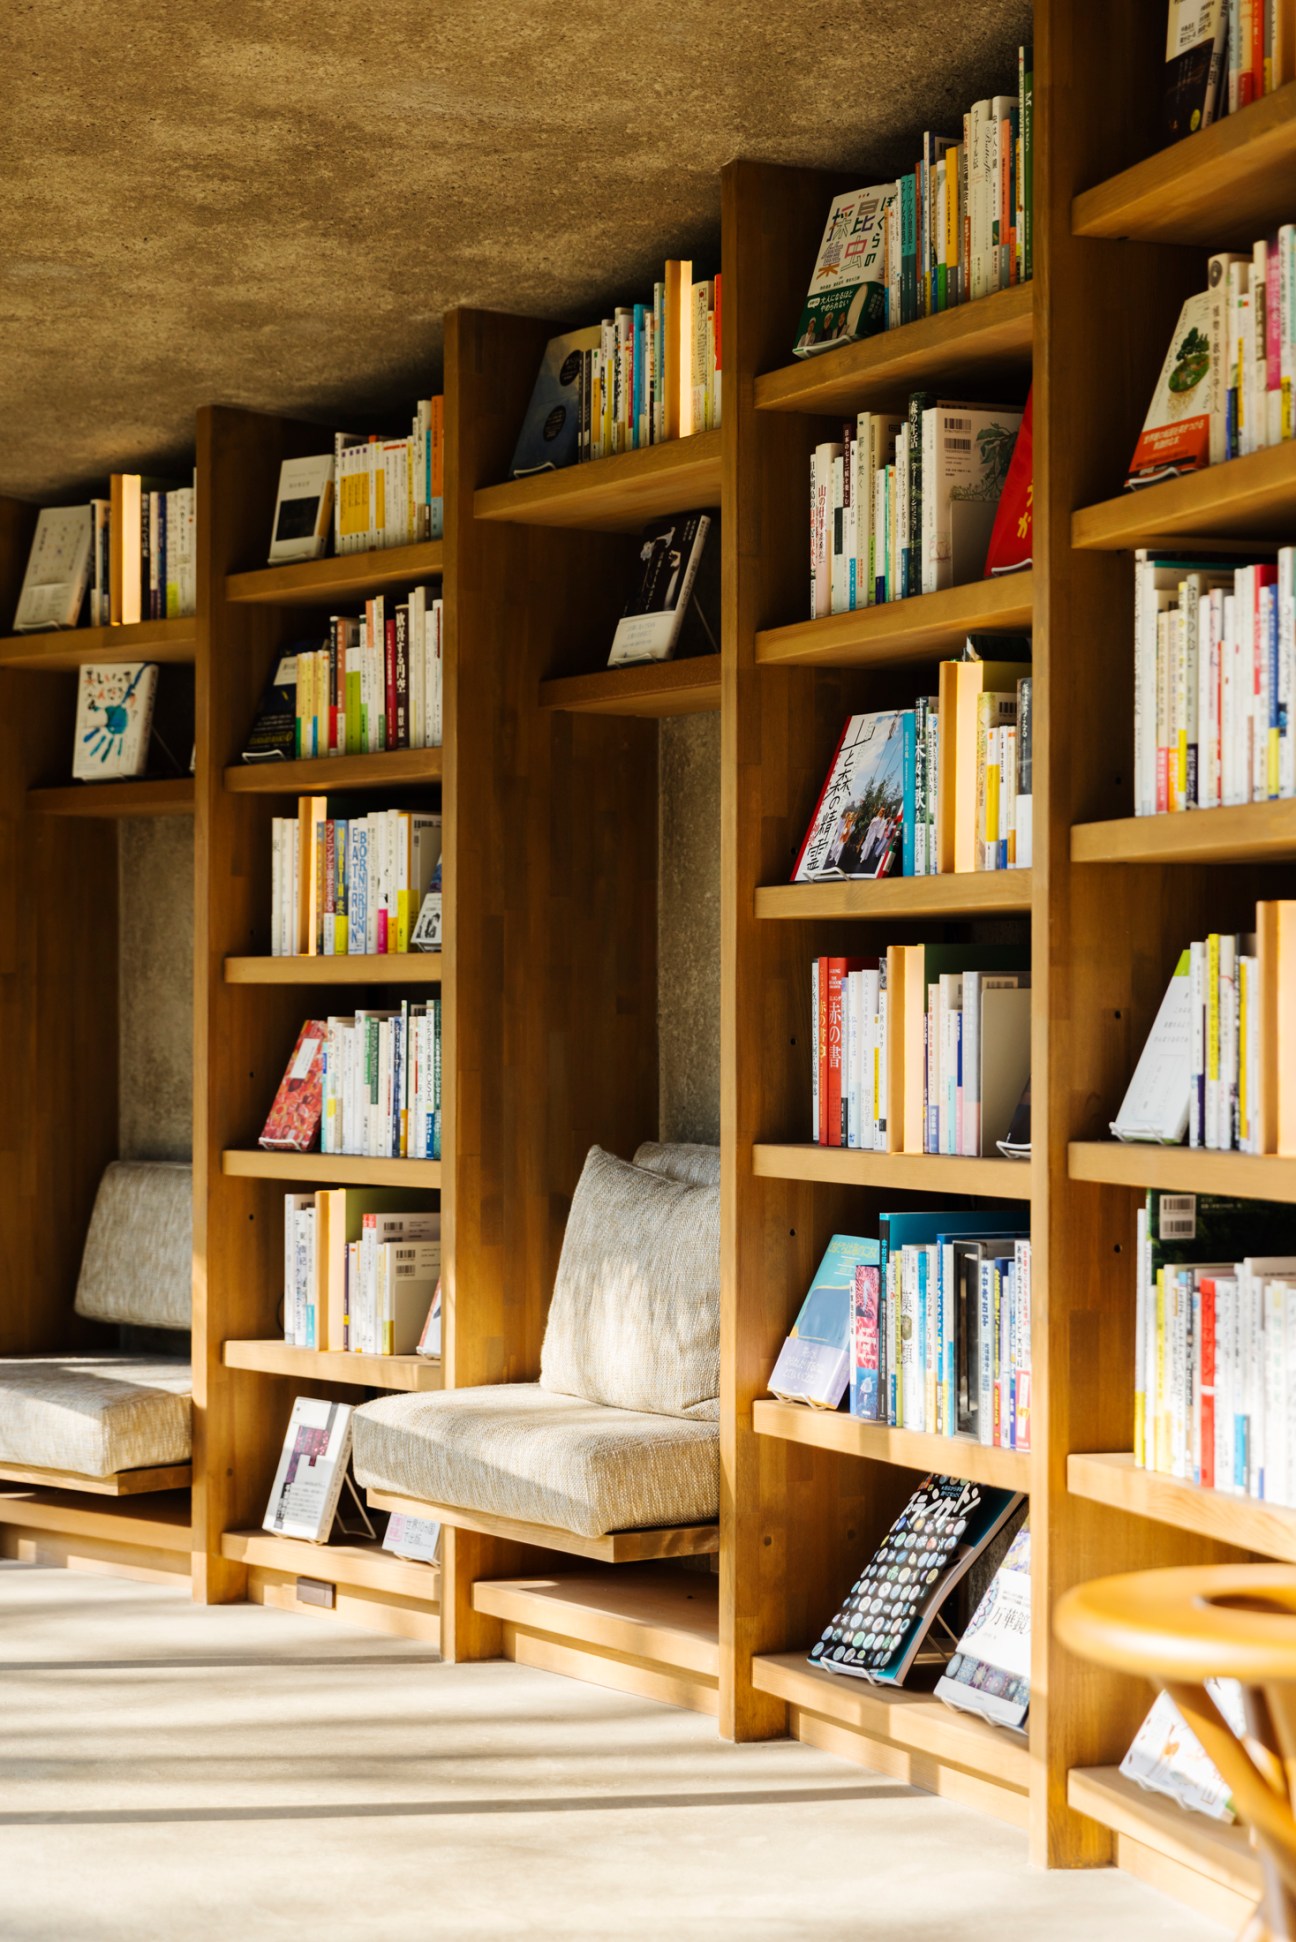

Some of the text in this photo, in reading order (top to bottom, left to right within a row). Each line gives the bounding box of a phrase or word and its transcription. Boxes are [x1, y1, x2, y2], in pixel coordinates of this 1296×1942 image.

[358, 893, 366, 934] RUN
[830, 1003, 843, 1068] 赤の書
